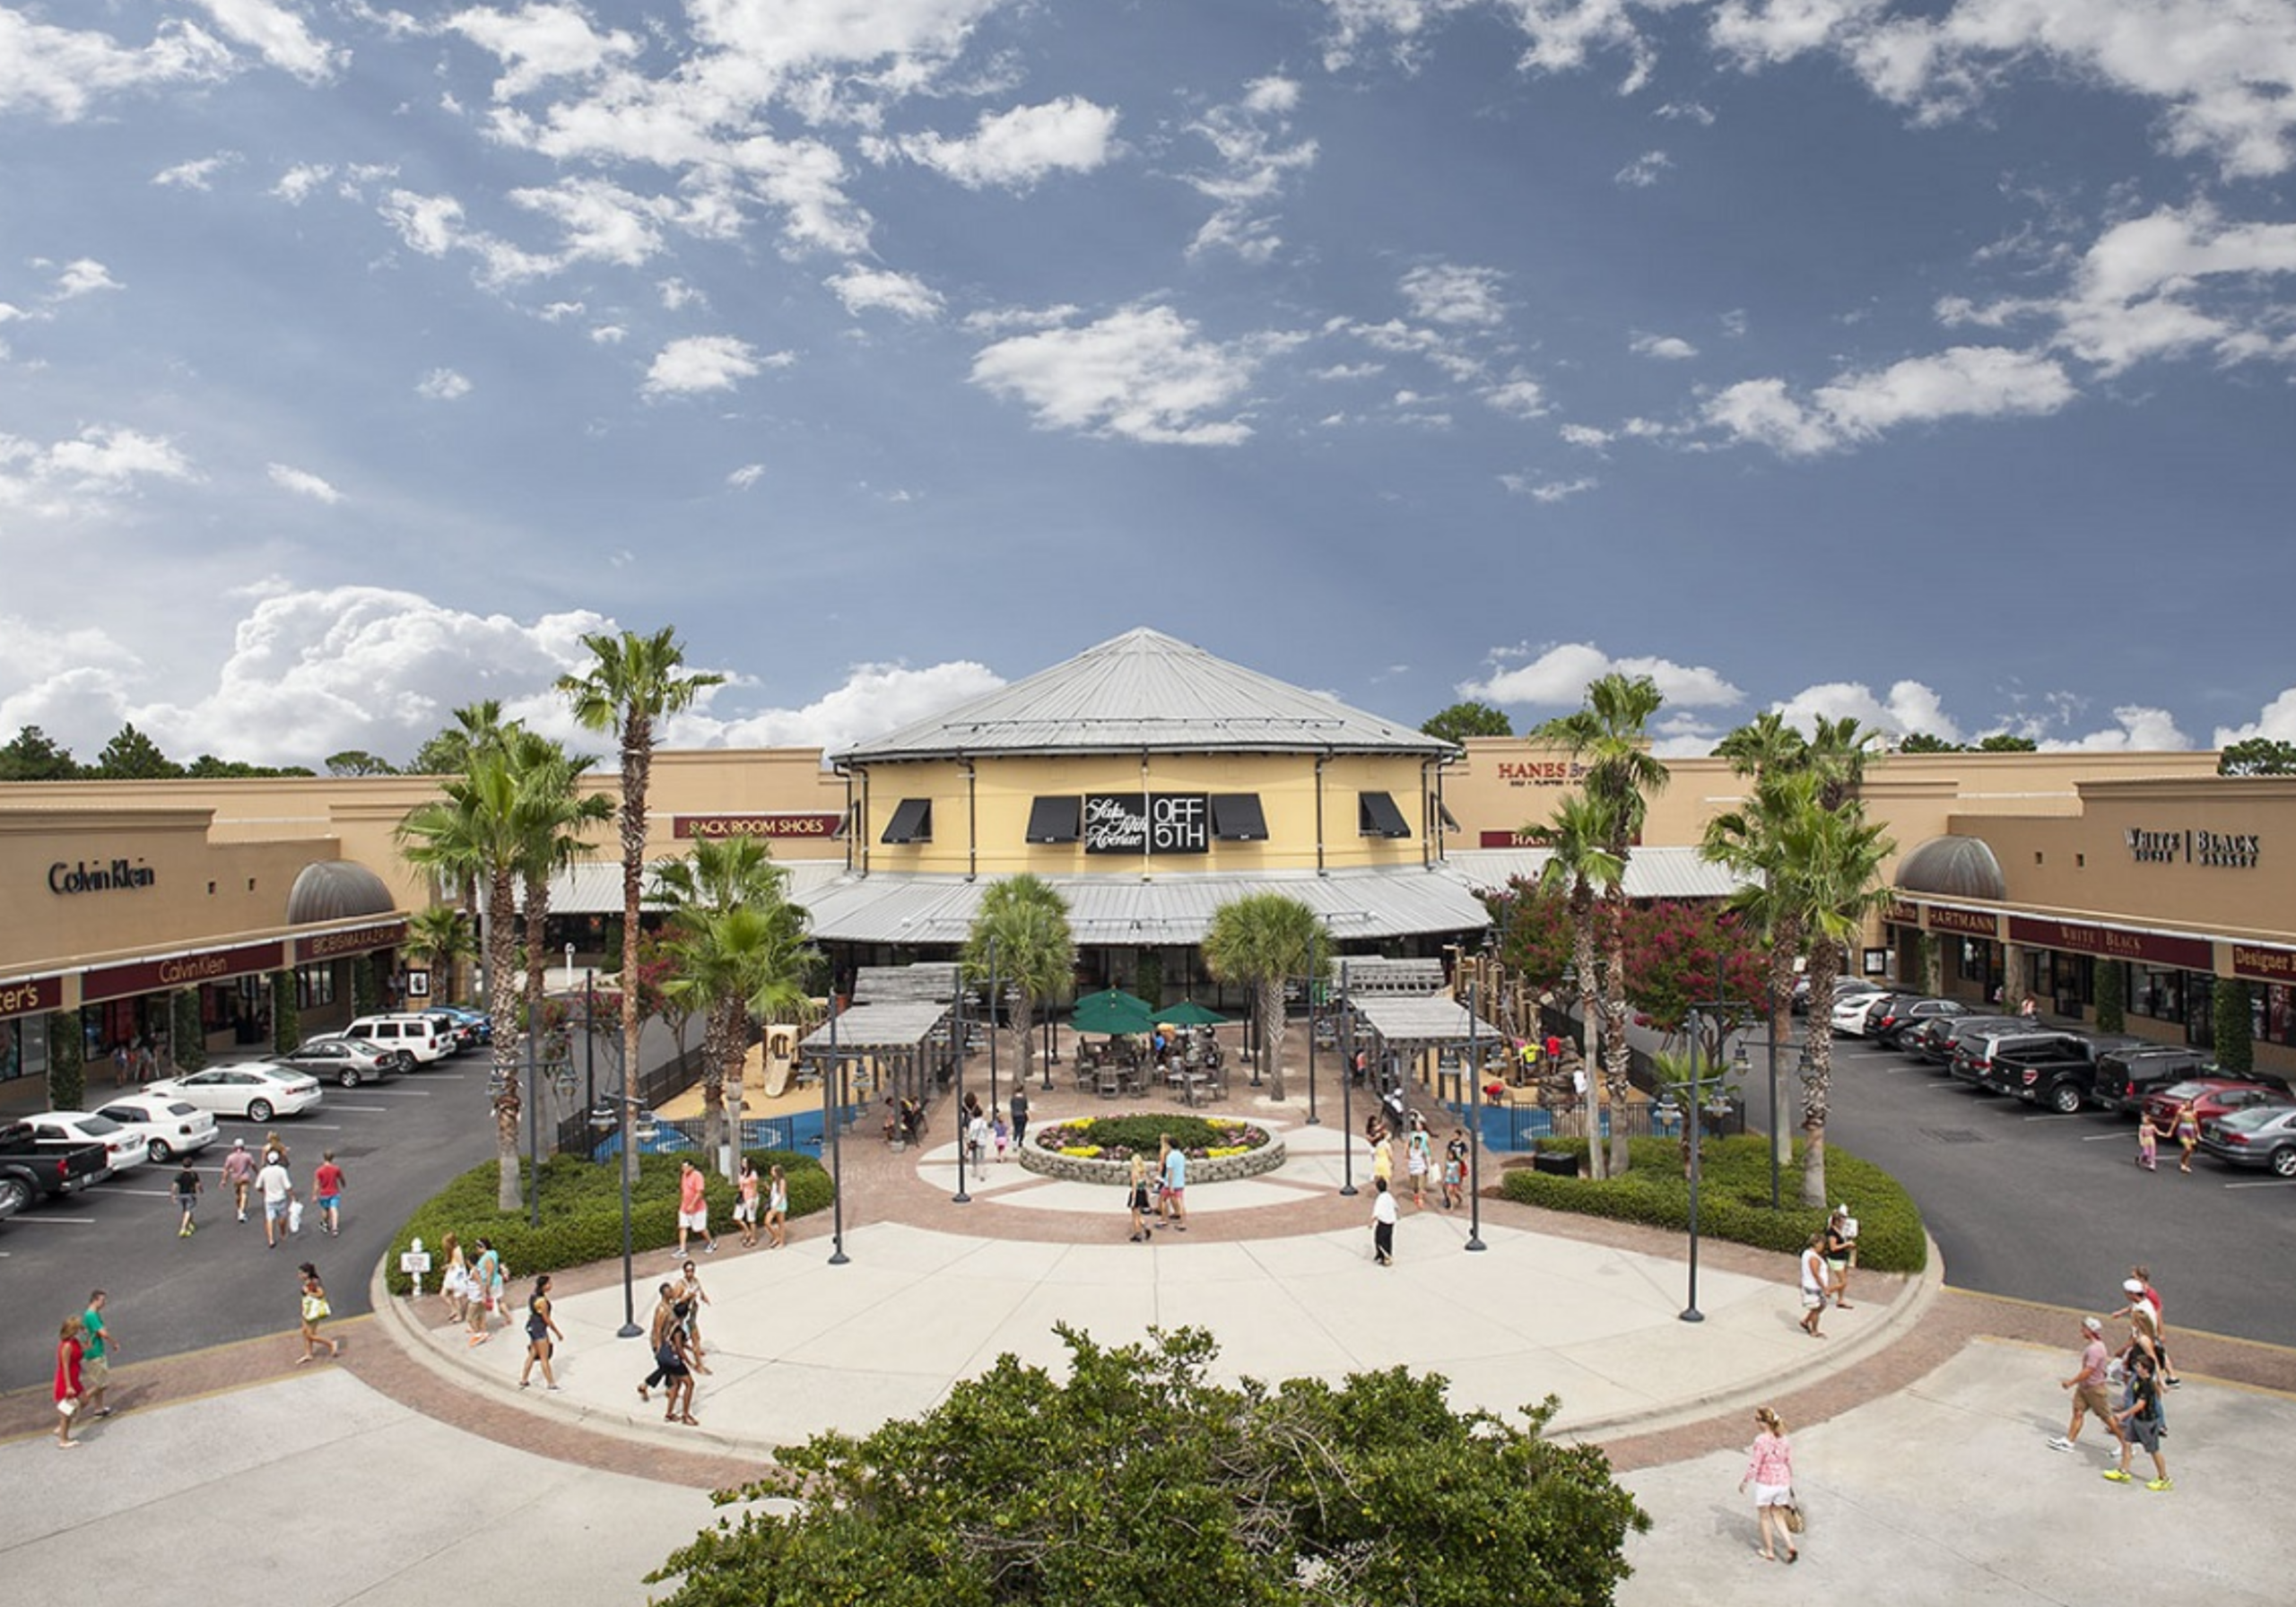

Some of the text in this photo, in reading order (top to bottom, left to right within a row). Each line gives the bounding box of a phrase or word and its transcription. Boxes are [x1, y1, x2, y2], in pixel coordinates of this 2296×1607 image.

[1498, 762, 1566, 779] HANES
[1153, 798, 1204, 823] OFF
[731, 820, 776, 834] ROOM
[778, 819, 824, 833] SHOES
[1155, 822, 1204, 848] 5TH
[48, 857, 155, 895] Calvin Klein
[159, 954, 228, 984] Calvin Klein
[2234, 946, 2289, 974] Designer
